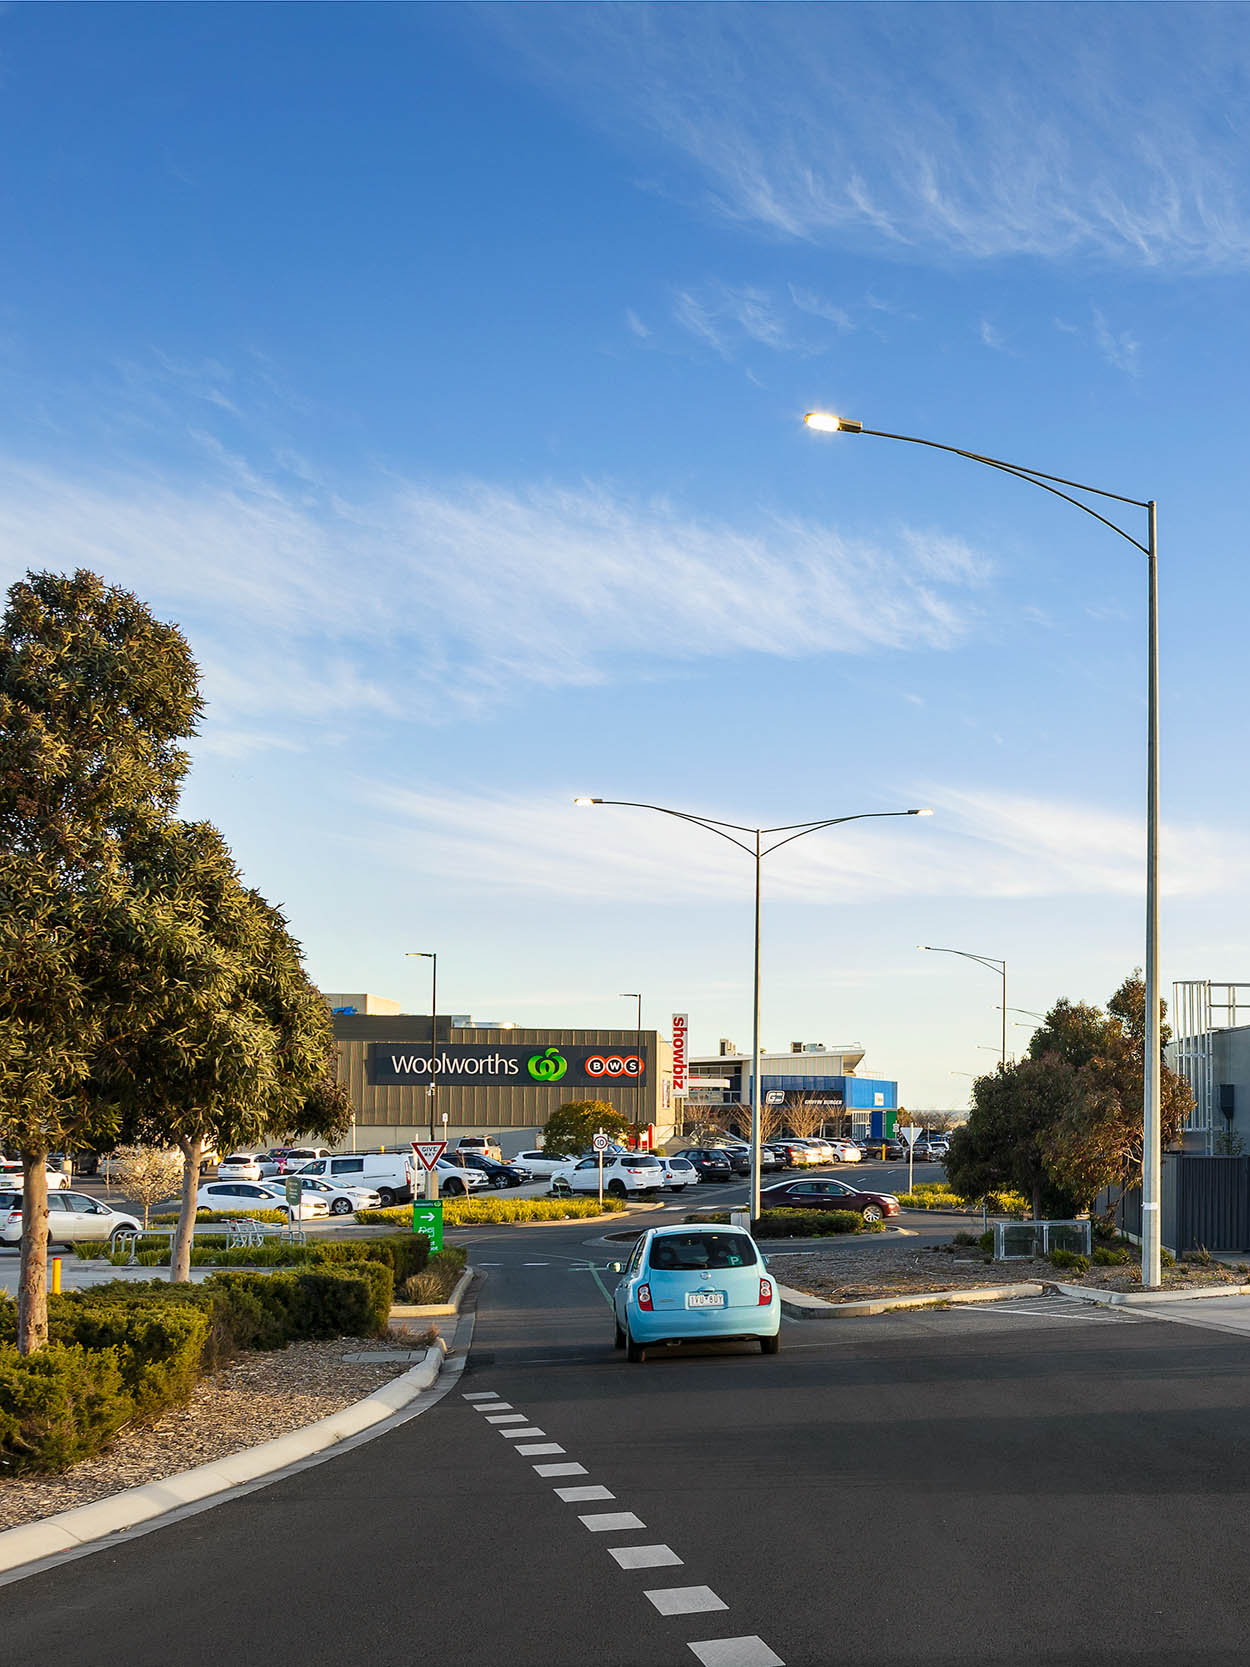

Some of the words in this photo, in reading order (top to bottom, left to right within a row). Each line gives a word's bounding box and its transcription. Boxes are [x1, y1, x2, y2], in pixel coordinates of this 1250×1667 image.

[673, 1017, 687, 1090] showbiz
[592, 1060, 638, 1072] BWS
[731, 1256, 739, 1265] P
